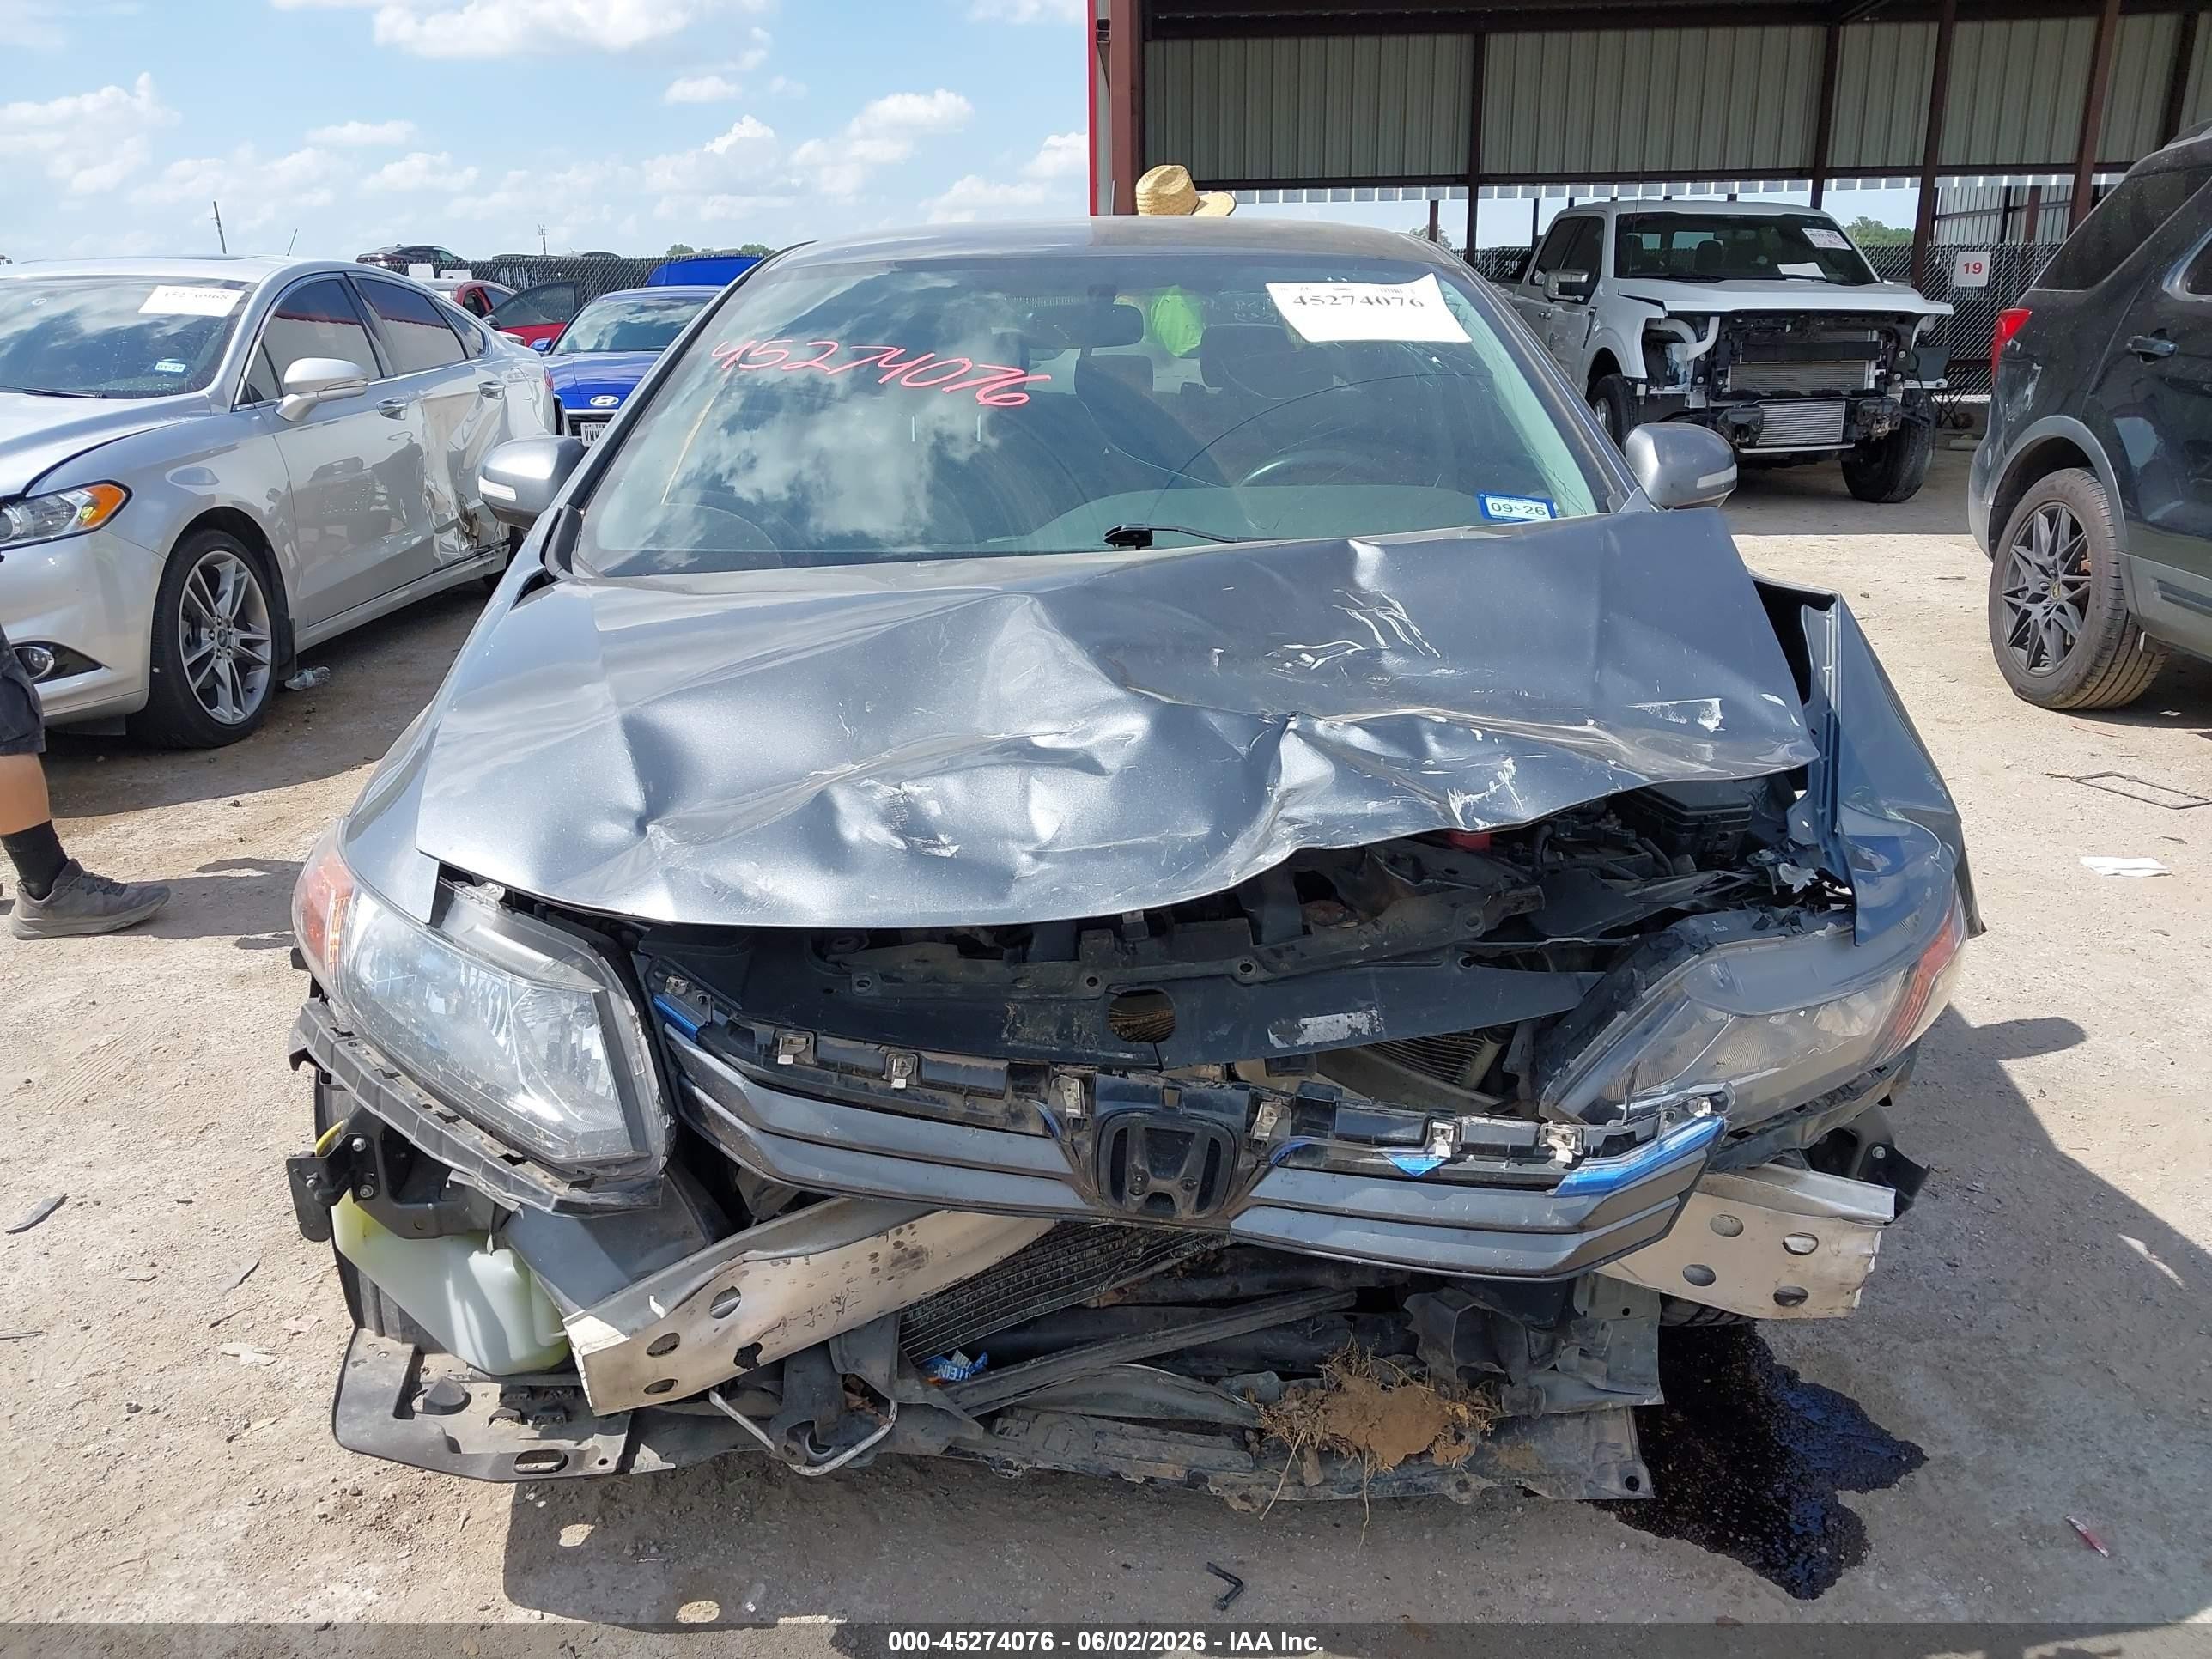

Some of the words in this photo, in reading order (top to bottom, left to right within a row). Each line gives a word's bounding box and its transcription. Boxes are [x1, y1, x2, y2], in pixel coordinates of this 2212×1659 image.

[1963, 262, 1983, 275] 19
[1292, 295, 1425, 307] 45274076
[710, 339, 1052, 406] 45274076
